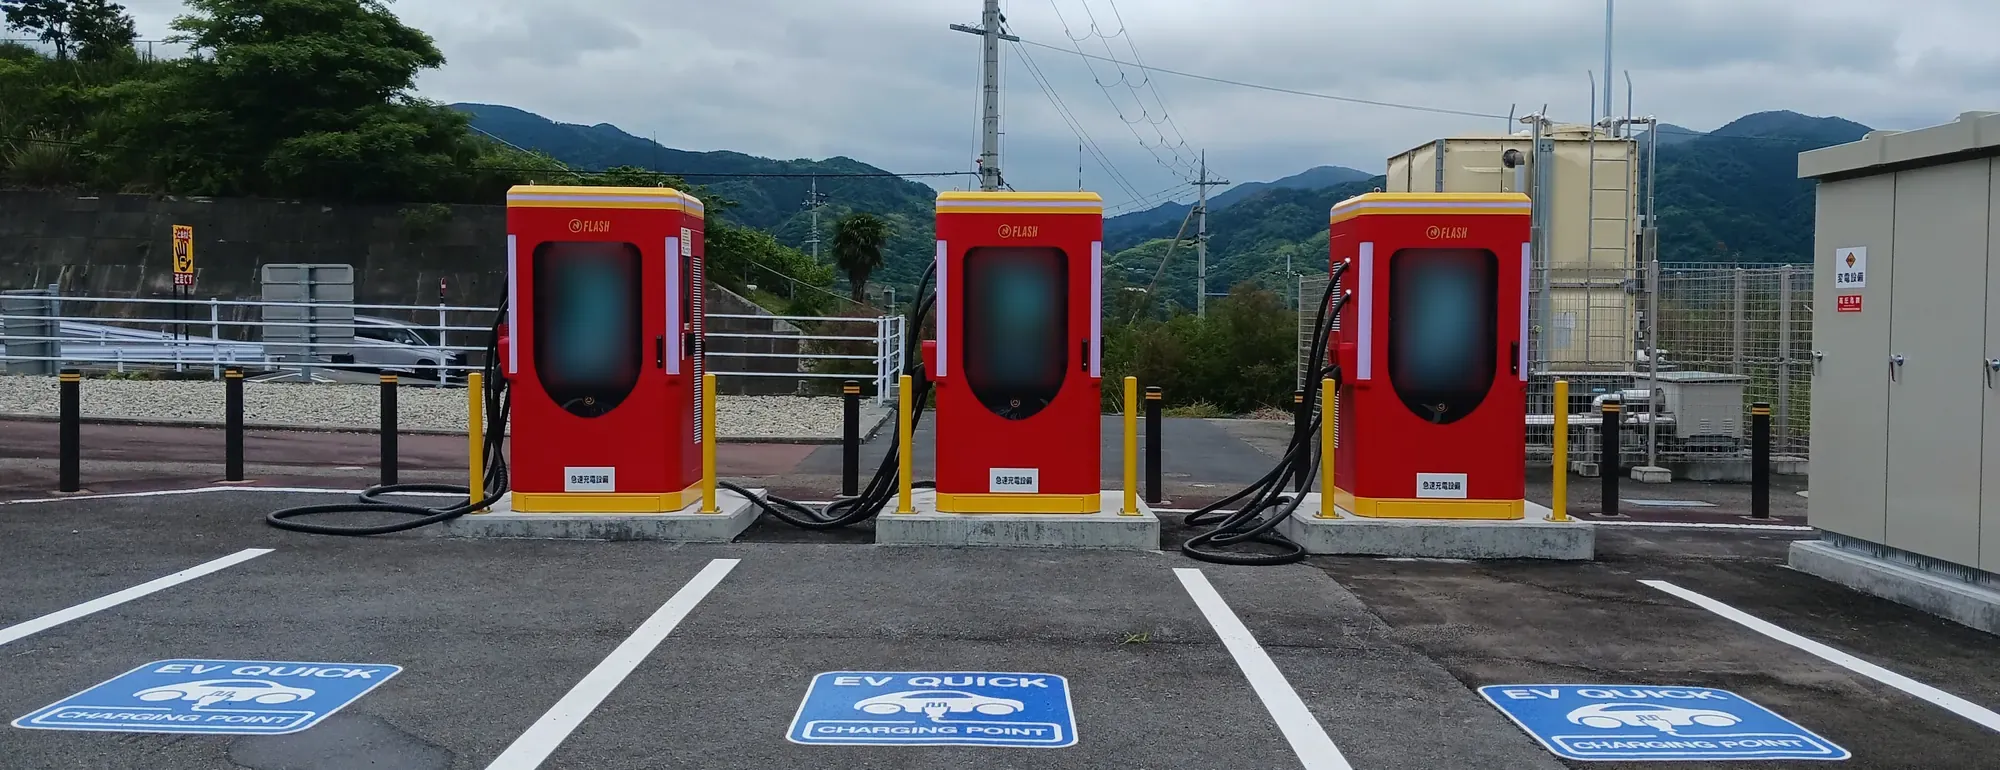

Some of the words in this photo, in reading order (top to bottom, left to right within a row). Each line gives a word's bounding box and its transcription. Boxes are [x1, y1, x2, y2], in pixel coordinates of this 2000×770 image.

[583, 220, 610, 232] FLASH
[1012, 226, 1039, 237] FLASH
[1441, 227, 1468, 239] FLASH
[1837, 272, 1864, 283] 変電設備
[570, 475, 609, 484] 急速充電設備
[995, 476, 1033, 485] 急速充電設備
[1422, 481, 1461, 490] 急速充電設備
[153, 663, 226, 675] EV
[231, 665, 381, 680] QUICK
[833, 676, 894, 687] EV
[907, 676, 1049, 688] QUICK
[1502, 688, 1560, 700] EV
[1576, 688, 1728, 700] QUICK
[57, 710, 200, 723] CHARGING
[200, 714, 295, 726] POINT
[817, 725, 958, 735] CHARGING
[966, 726, 1048, 736] POINT
[1573, 740, 1718, 750] CHARGING
[1721, 740, 1804, 750] POINT
